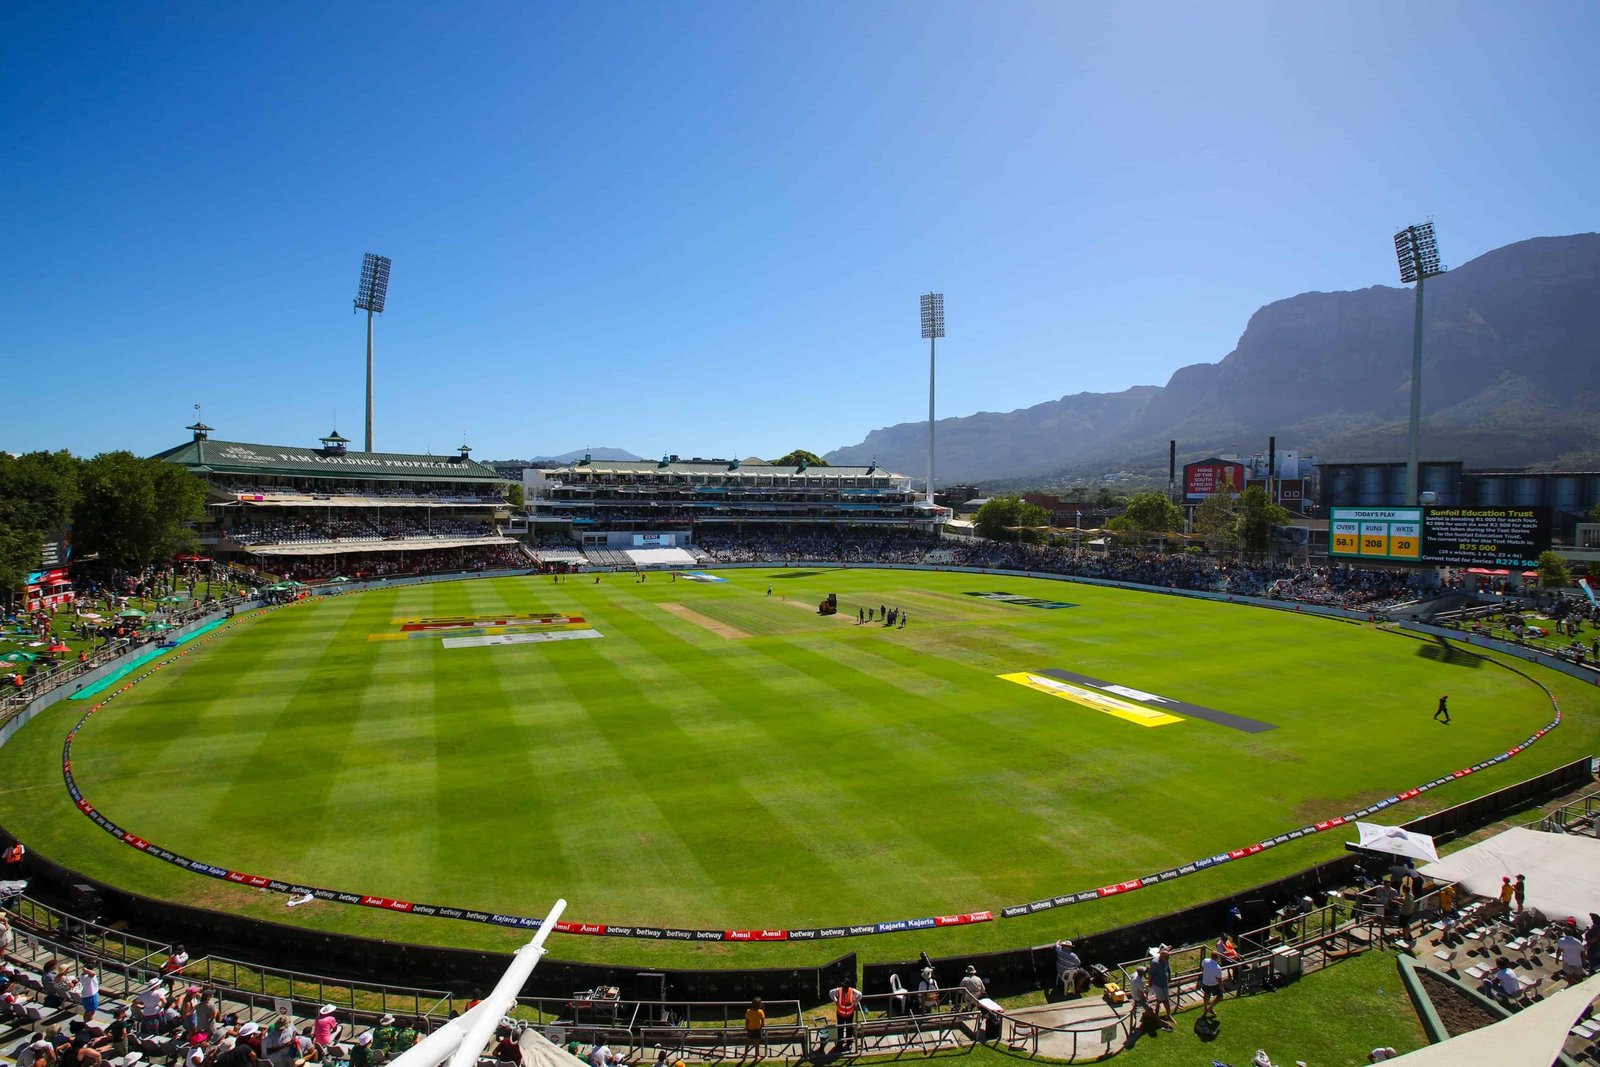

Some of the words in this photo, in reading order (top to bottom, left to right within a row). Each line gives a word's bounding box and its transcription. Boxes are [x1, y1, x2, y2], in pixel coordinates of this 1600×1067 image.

[279, 454, 312, 462] PAM
[315, 456, 381, 466] GOLDING
[386, 460, 468, 469] PROPERTIES
[269, 881, 288, 891] betway
[291, 886, 312, 894] betway
[315, 889, 336, 900] betway
[339, 894, 360, 903] betway
[391, 901, 408, 909] Amul
[413, 905, 436, 914] betway
[440, 908, 462, 918] betway
[466, 912, 489, 921] betway
[492, 914, 518, 924] Kajaria
[607, 926, 632, 935] betway
[636, 928, 661, 937] betway
[666, 930, 692, 939] betway
[697, 931, 722, 940] betway
[850, 926, 875, 934] betway
[880, 922, 905, 930] Kajaria
[908, 918, 934, 927] Kajaria
[1004, 907, 1027, 915] betway
[1030, 901, 1051, 910] betway
[1054, 896, 1074, 904] betway
[1077, 892, 1097, 900] betway
[1141, 876, 1158, 884] betway
[1160, 871, 1177, 880] betway
[1178, 865, 1195, 874] betway
